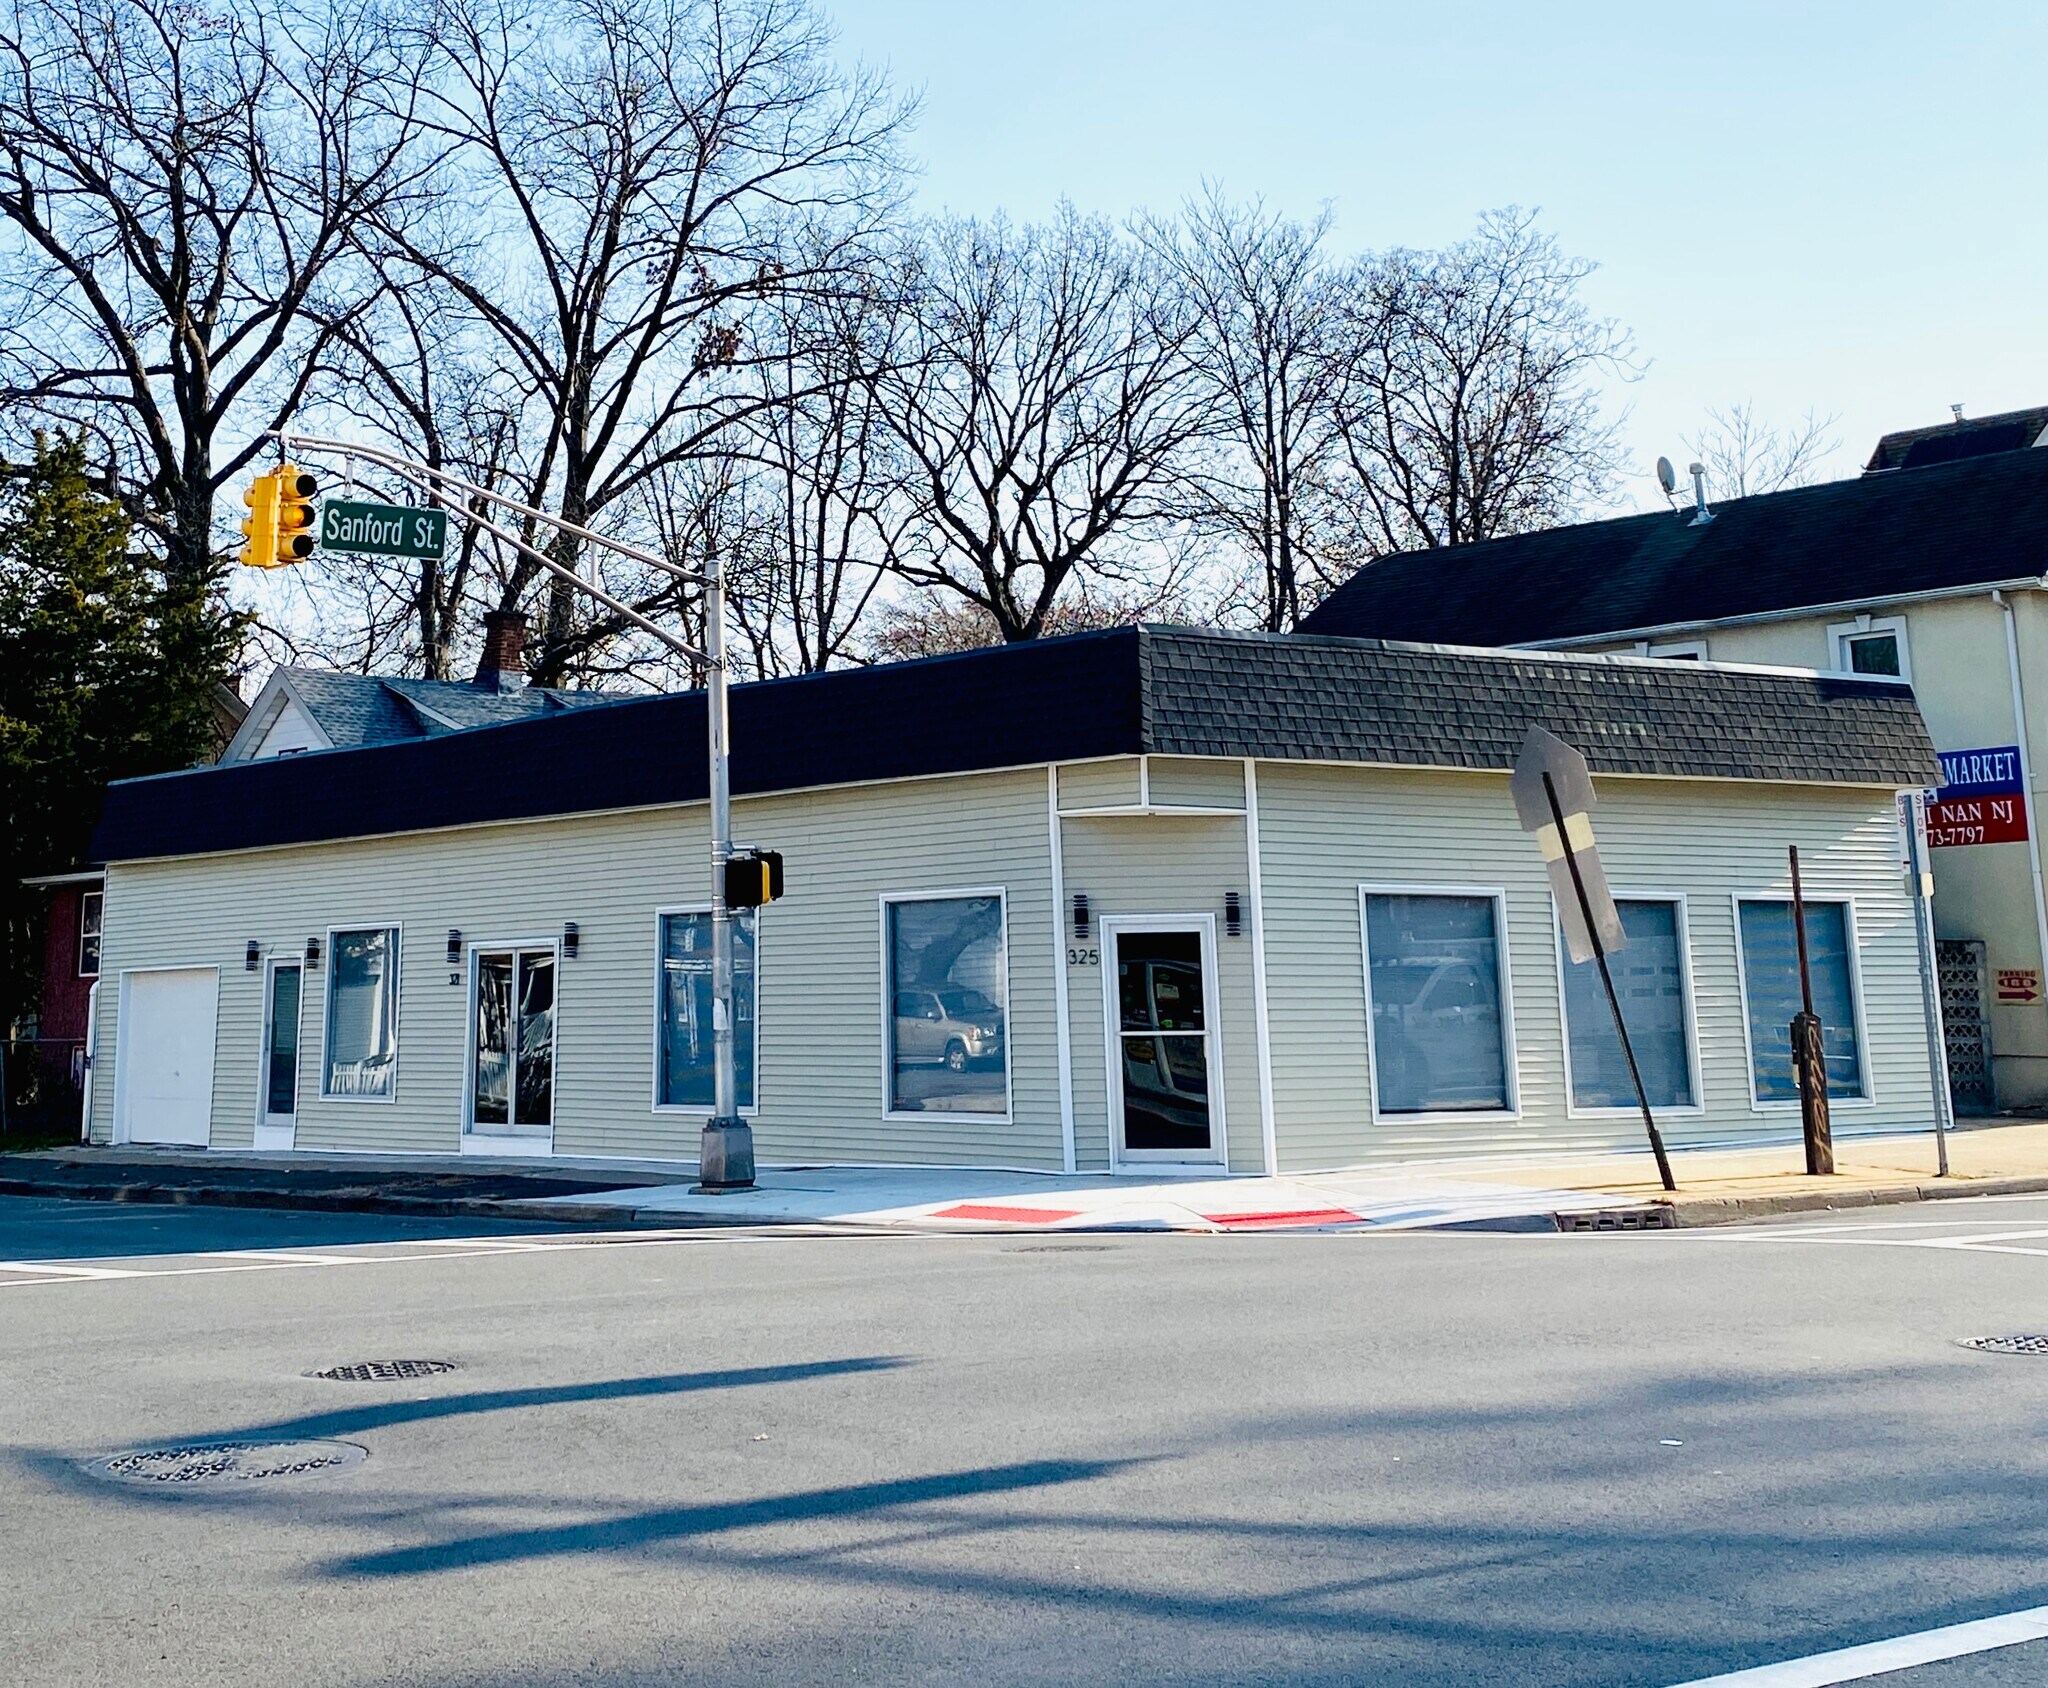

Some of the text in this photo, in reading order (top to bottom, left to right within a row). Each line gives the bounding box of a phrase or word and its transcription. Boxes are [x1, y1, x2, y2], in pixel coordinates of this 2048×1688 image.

[325, 508, 439, 550] Sanford St.
[1897, 794, 1925, 838] BUS STOP
[1941, 802, 1982, 823] NAN
[1990, 800, 2013, 824] NJ
[1068, 949, 1099, 965] 325
